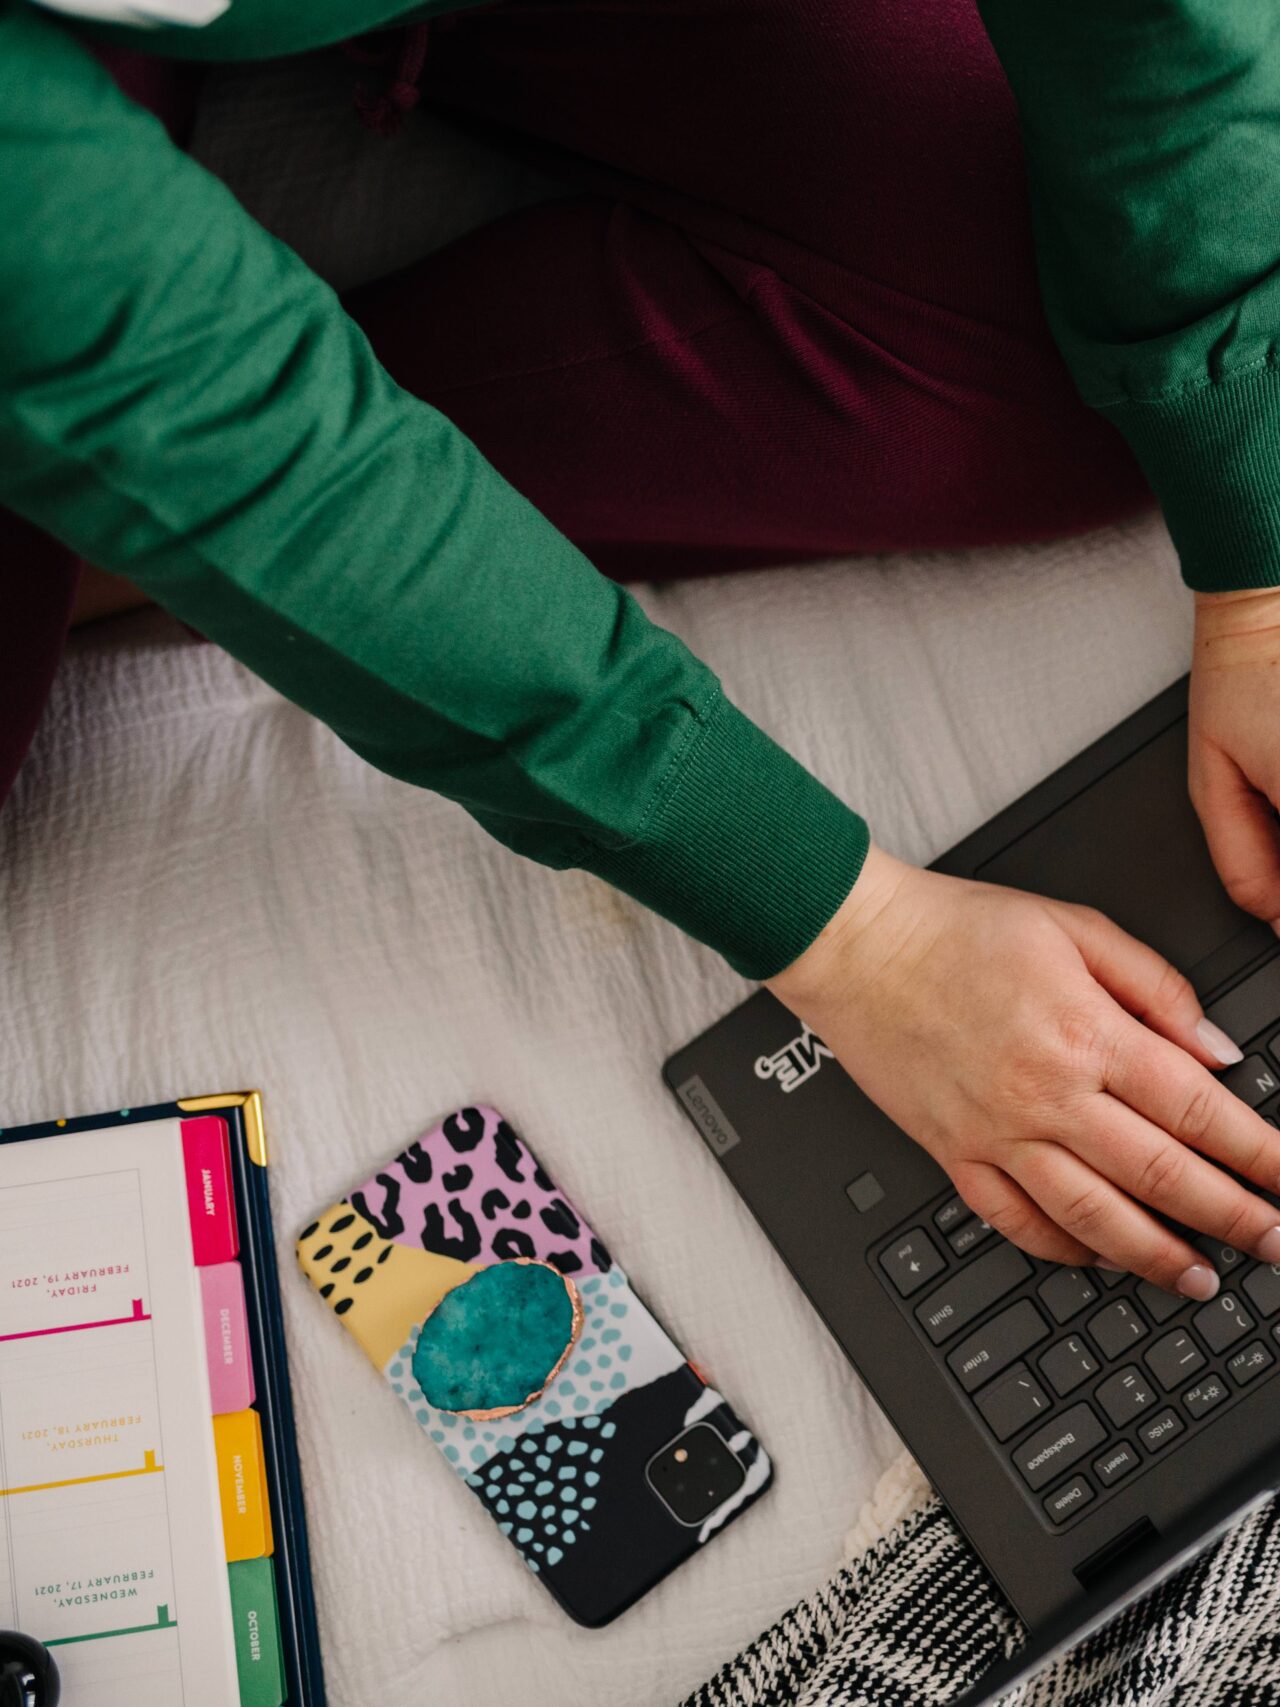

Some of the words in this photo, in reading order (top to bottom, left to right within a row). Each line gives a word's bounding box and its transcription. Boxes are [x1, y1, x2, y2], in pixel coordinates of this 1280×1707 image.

[1256, 1072, 1274, 1092] N
[685, 1086, 728, 1145] Lenovo
[202, 1168, 214, 1216] JANUARY
[11, 1276, 38, 1289] 2021
[42, 1274, 59, 1285] 19,
[64, 1265, 129, 1282] FEBRUARY
[46, 1284, 97, 1298] FRIDAY,
[929, 1304, 953, 1326] Shift
[1236, 1315, 1246, 1327] )
[220, 1308, 234, 1365] DECEMBER
[1068, 1341, 1078, 1352] ]
[962, 1350, 989, 1373] Enter
[1232, 1354, 1245, 1367] F11
[1122, 1375, 1135, 1387] =
[1135, 1392, 1145, 1402] +
[53, 1424, 72, 1434] 18,
[75, 1415, 142, 1434] FEBRUARY
[1148, 1418, 1174, 1439] PrtSc
[21, 1428, 49, 1441] 2021
[46, 1434, 120, 1452] THURSDAY,
[1027, 1432, 1076, 1470] Backspace
[1103, 1452, 1129, 1474] Insert
[233, 1455, 247, 1515] NOVEMBER
[1054, 1487, 1082, 1509] Delete
[66, 1580, 82, 1590] 17,
[87, 1569, 154, 1588] FEBRUARY
[34, 1582, 61, 1595] 2021
[53, 1587, 138, 1608] WEDNESDAY,
[248, 1610, 261, 1662] OCTOBER
